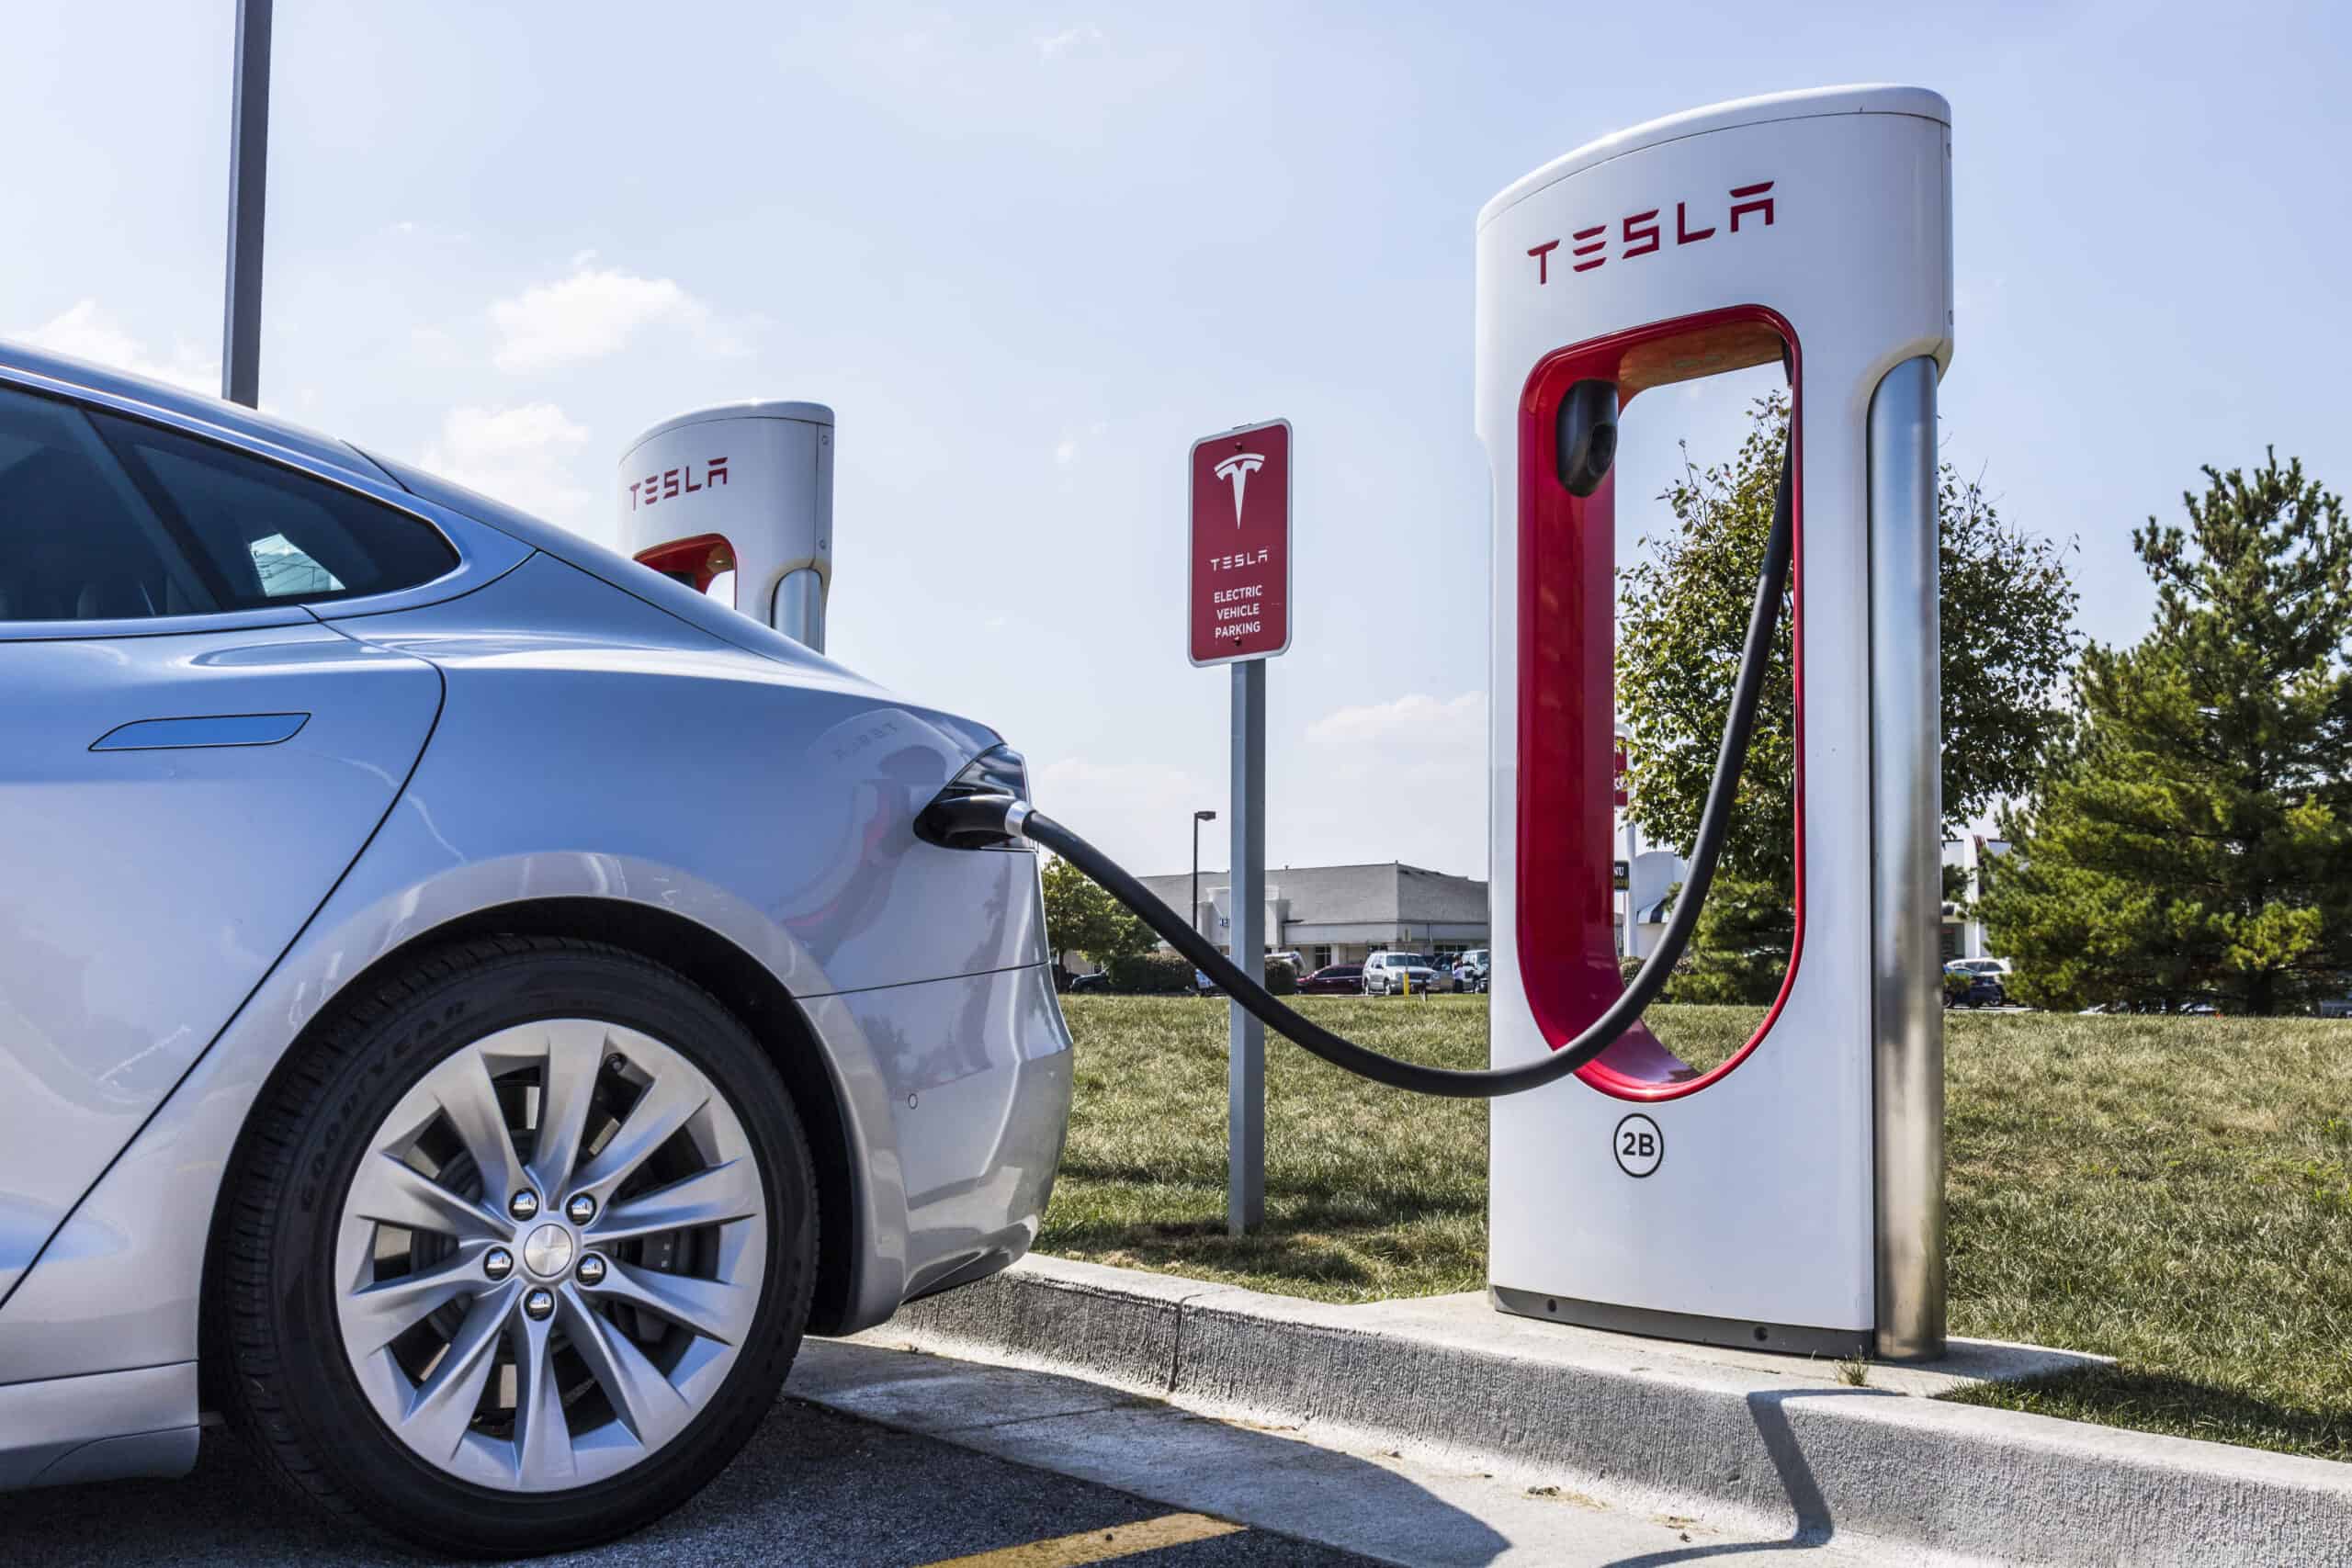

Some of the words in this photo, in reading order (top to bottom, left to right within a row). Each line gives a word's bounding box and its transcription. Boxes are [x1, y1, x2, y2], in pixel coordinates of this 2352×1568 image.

[1526, 180, 1775, 285] TESLA
[629, 456, 729, 512] TESLA
[1210, 549, 1268, 571] TESLA
[1214, 584, 1262, 604] ELECTRIC
[1216, 603, 1260, 621] VEHICLE
[1215, 620, 1261, 638] PARKING
[1622, 1131, 1656, 1157] 2B
